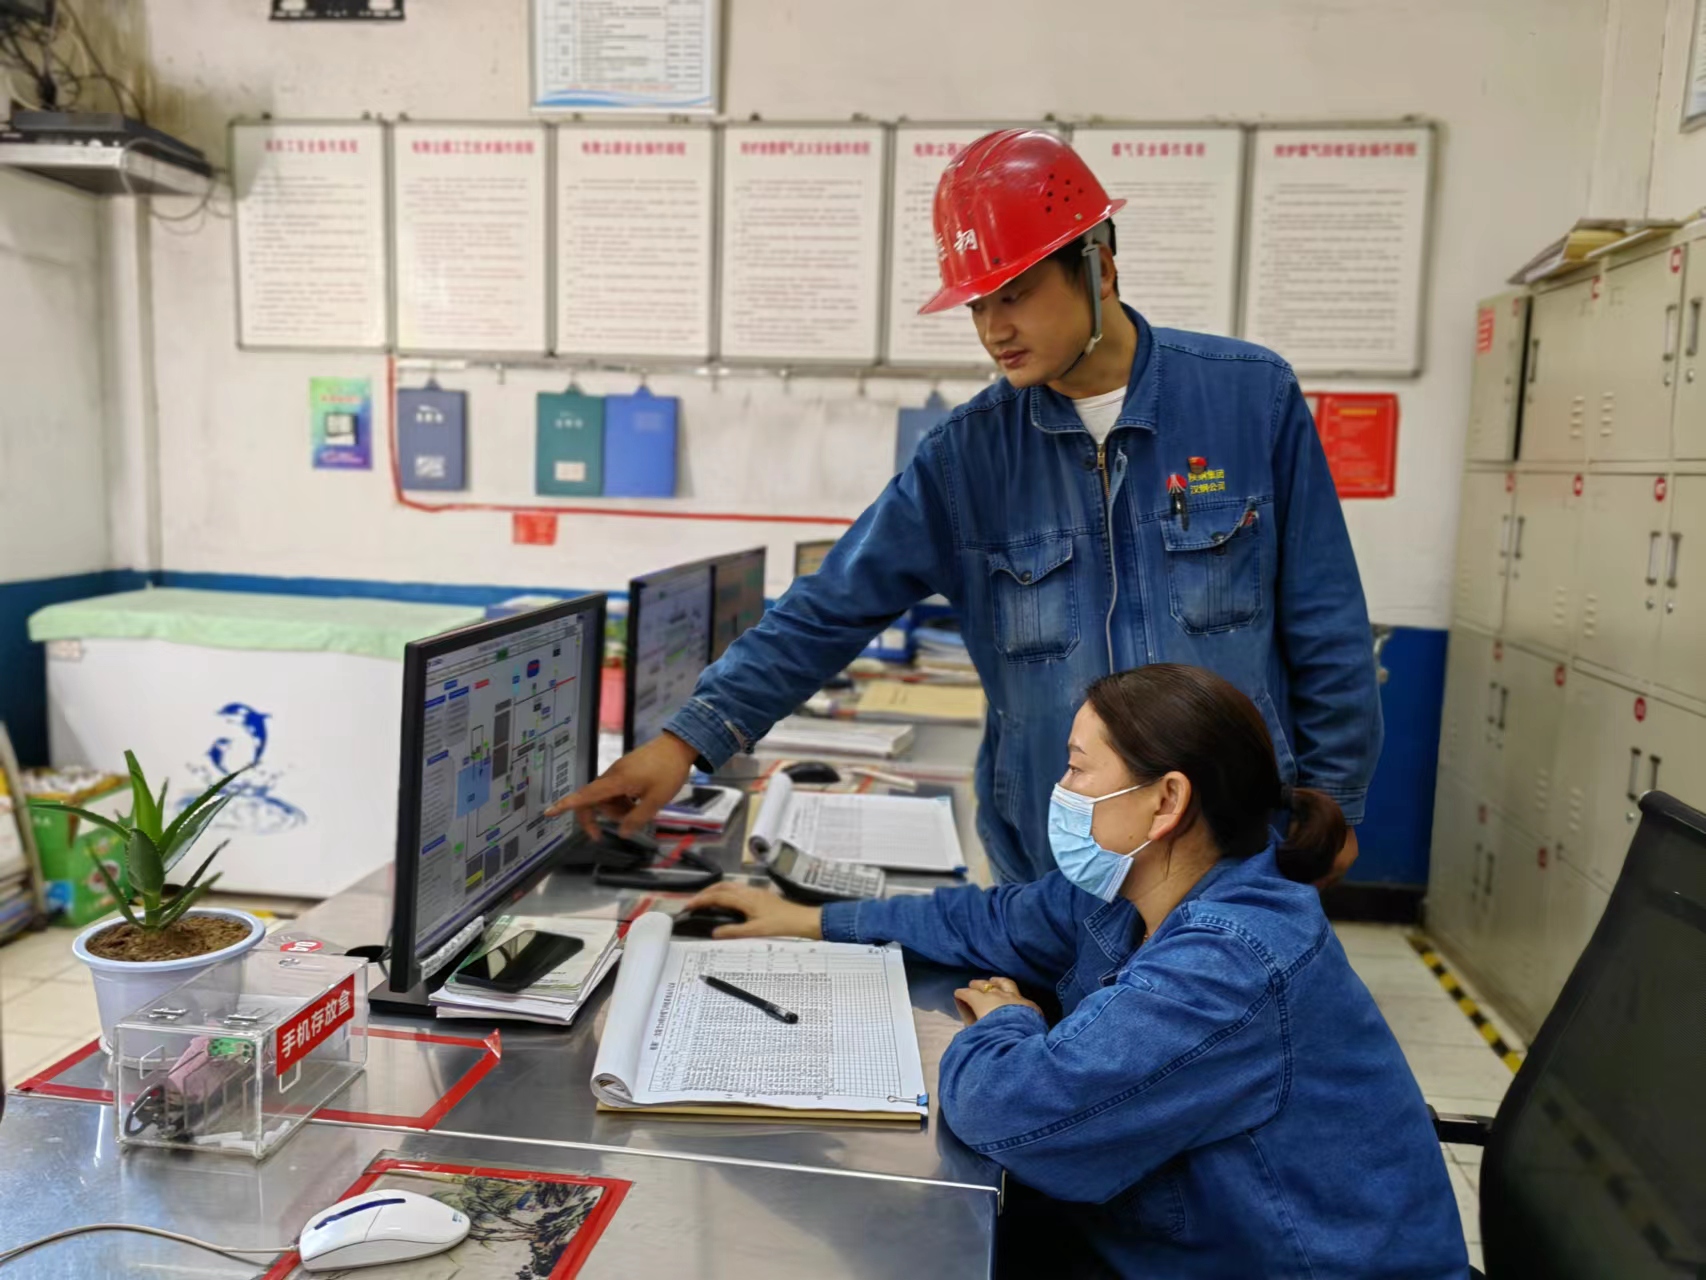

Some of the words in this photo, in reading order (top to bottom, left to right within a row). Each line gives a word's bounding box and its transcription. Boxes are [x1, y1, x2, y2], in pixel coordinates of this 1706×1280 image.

[281, 989, 351, 1059] 手机存放盒
